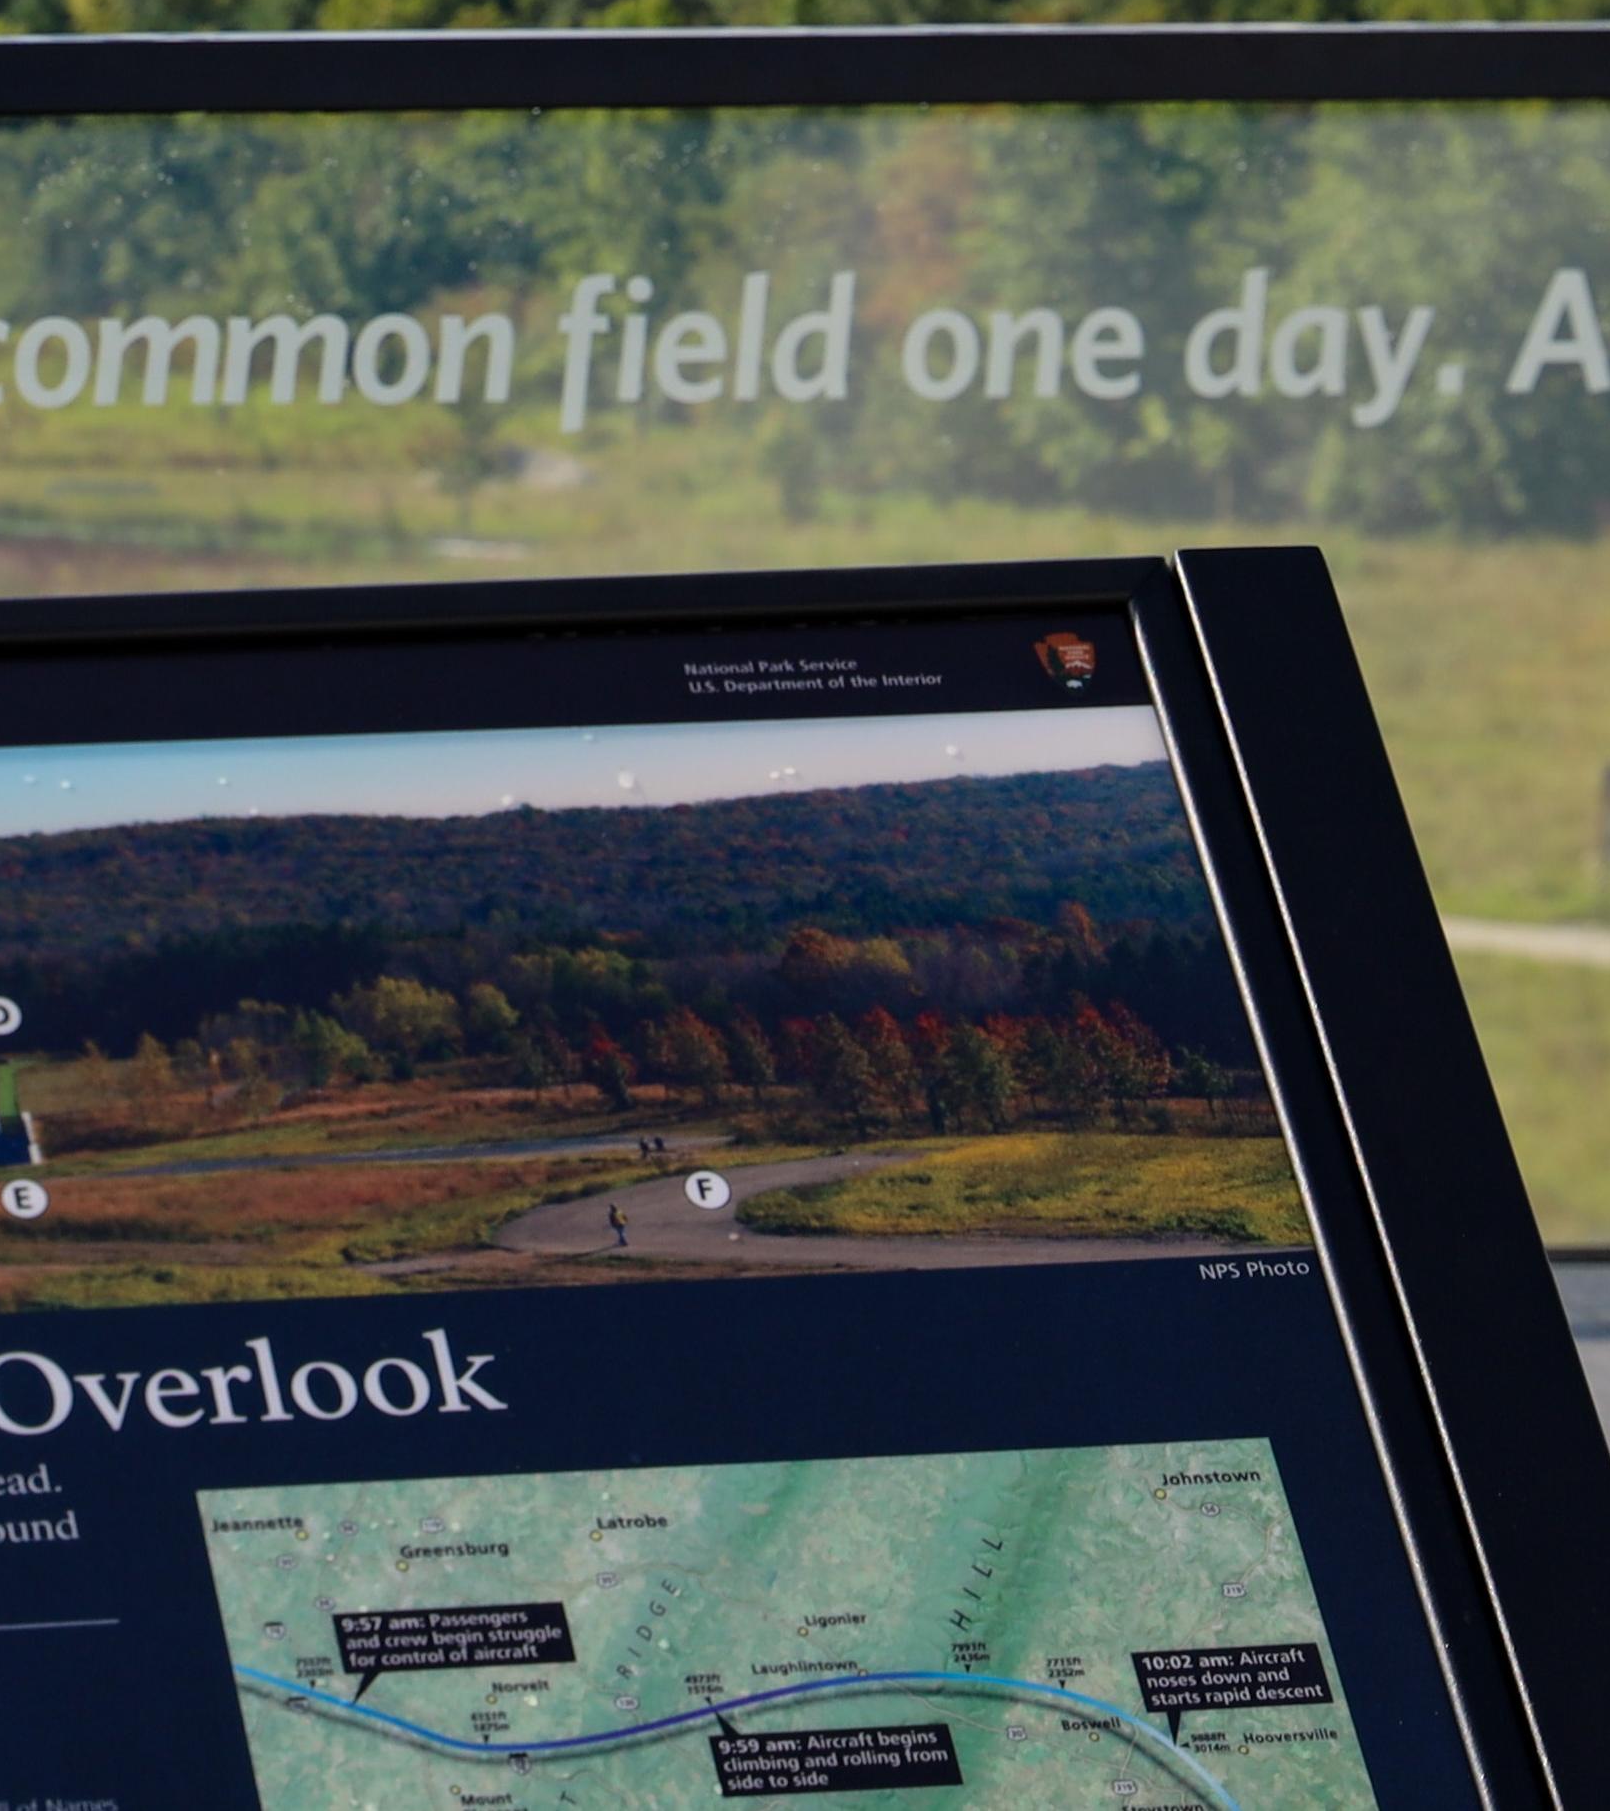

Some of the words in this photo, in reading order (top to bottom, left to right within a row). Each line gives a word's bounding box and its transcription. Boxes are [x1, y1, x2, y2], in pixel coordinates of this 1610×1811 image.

[560, 269, 855, 432] field
[902, 307, 1145, 401] one
[1184, 269, 1462, 425] day.
[1506, 267, 1610, 393] A
[683, 660, 755, 676] National
[758, 659, 795, 673] Park
[798, 658, 857, 672] Service
[689, 679, 719, 694] U.S.
[723, 677, 824, 694] Department
[827, 675, 845, 689] of
[849, 675, 878, 688] the
[881, 674, 942, 686] Interior
[13, 1186, 31, 1210] E
[696, 1178, 712, 1201] F
[1199, 1262, 1241, 1280] NPS
[1246, 1260, 1310, 1278] Photo
[1162, 1471, 1261, 1487] Johnstown
[212, 1516, 304, 1533] Jeannette
[596, 1514, 668, 1530] Latrobe
[399, 1542, 510, 1560] Greensburg
[950, 1538, 1003, 1631] HILL
[341, 1616, 382, 1633] 9:57
[388, 1617, 425, 1630] am:
[428, 1611, 529, 1629] Passengers
[804, 1613, 867, 1629] Ligonier
[346, 1634, 381, 1650] and
[384, 1634, 428, 1648] crew
[433, 1628, 484, 1647] begin
[489, 1624, 562, 1644] struggle
[349, 1652, 376, 1667] for
[380, 1648, 445, 1666] control
[449, 1645, 470, 1664] of
[474, 1643, 539, 1660] aircraft
[1141, 1654, 1193, 1671] 10:02
[1199, 1655, 1234, 1668] am:
[1239, 1647, 1306, 1666] Aircraft
[751, 1660, 859, 1676] Laughlintown
[1146, 1675, 1197, 1689] noses
[1201, 1670, 1253, 1686] down
[1257, 1666, 1290, 1683] and
[491, 1679, 549, 1694] Norvelt
[1151, 1691, 1201, 1706] starts
[1205, 1686, 1251, 1706] rapid
[1255, 1684, 1324, 1700] descent
[1061, 1717, 1121, 1731] Boswell
[718, 1738, 760, 1755] 9:59
[765, 1739, 802, 1752] am:
[807, 1731, 874, 1750] Aircraft
[878, 1730, 937, 1747] begins
[1242, 1727, 1338, 1745] Hooversville
[723, 1755, 800, 1773] climbing
[804, 1752, 838, 1768] and
[842, 1750, 901, 1767] rolling
[906, 1747, 948, 1761] from
[727, 1774, 764, 1791] side
[768, 1774, 789, 1788] to
[792, 1770, 829, 1787] side
[461, 1793, 512, 1806] Mount
